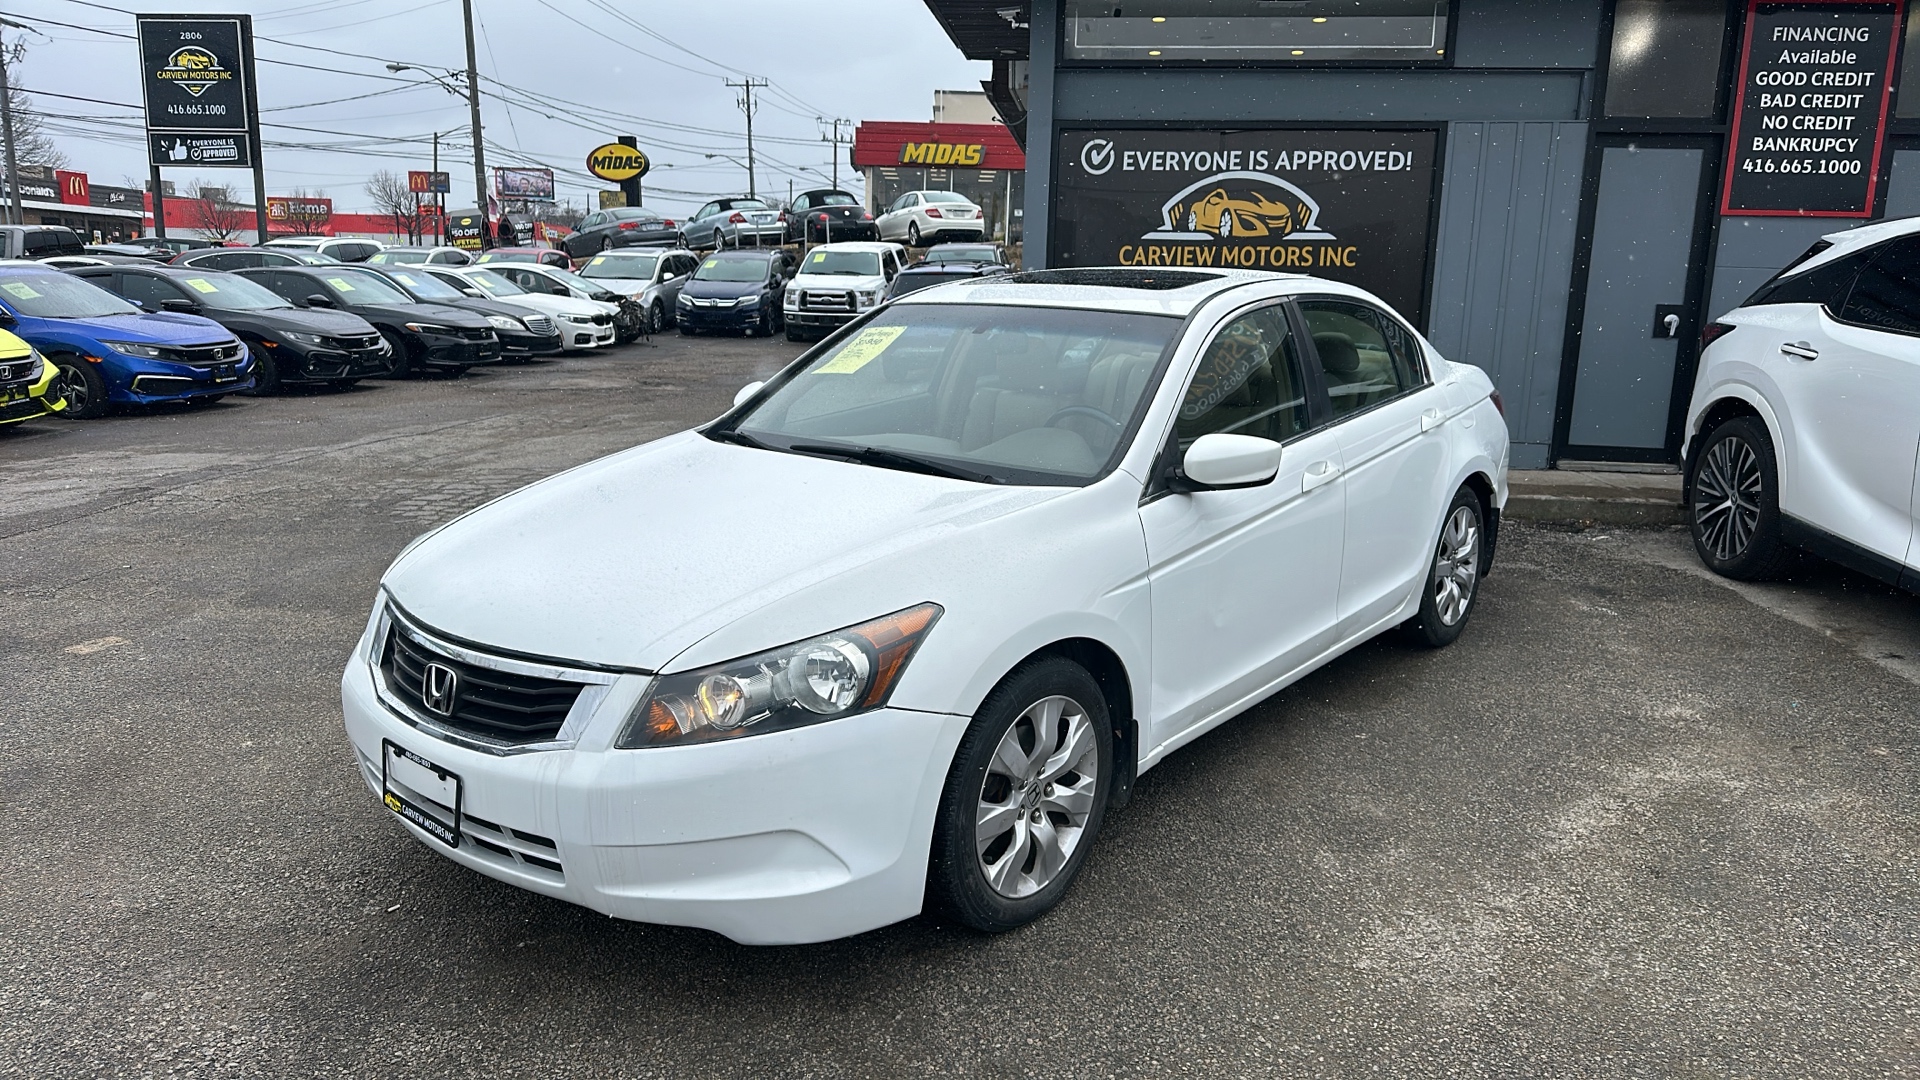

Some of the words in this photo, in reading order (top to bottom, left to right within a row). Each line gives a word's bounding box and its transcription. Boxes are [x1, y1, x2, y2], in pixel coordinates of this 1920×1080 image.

[179, 31, 203, 40] 2806
[1772, 26, 1870, 42] FINANCING
[1778, 49, 1857, 65] Available
[156, 71, 189, 79] CARVIEW
[190, 71, 219, 79] MOTORS
[219, 71, 232, 79] INC
[1755, 71, 1807, 86] GOOD
[1811, 72, 1875, 87] CREDIT
[1760, 93, 1796, 108] BAD
[1800, 94, 1864, 109] CREDIT
[167, 104, 226, 115] 416.665.1000
[1762, 115, 1788, 130] NO
[1792, 116, 1856, 131] CREDIT
[192, 139, 227, 147] EVERYONE
[1752, 137, 1859, 153] BANKRUPCY
[203, 148, 236, 158] APPROVED
[904, 143, 981, 165] MIDAS
[1122, 151, 1242, 171] EVERYONE
[1248, 150, 1268, 171] IS
[1274, 151, 1413, 172] APPROVED!
[593, 156, 644, 170] MIDAS
[1742, 158, 1861, 175] 416.665.1000
[464, 228, 479, 236] OFF
[1118, 245, 1216, 266] CARVIEW
[1221, 246, 1313, 267] MOTORS
[1318, 246, 1357, 267] INC
[402, 804, 424, 825] CARVIEW
[424, 818, 445, 838] MOTORS
[445, 831, 454, 843] INC
